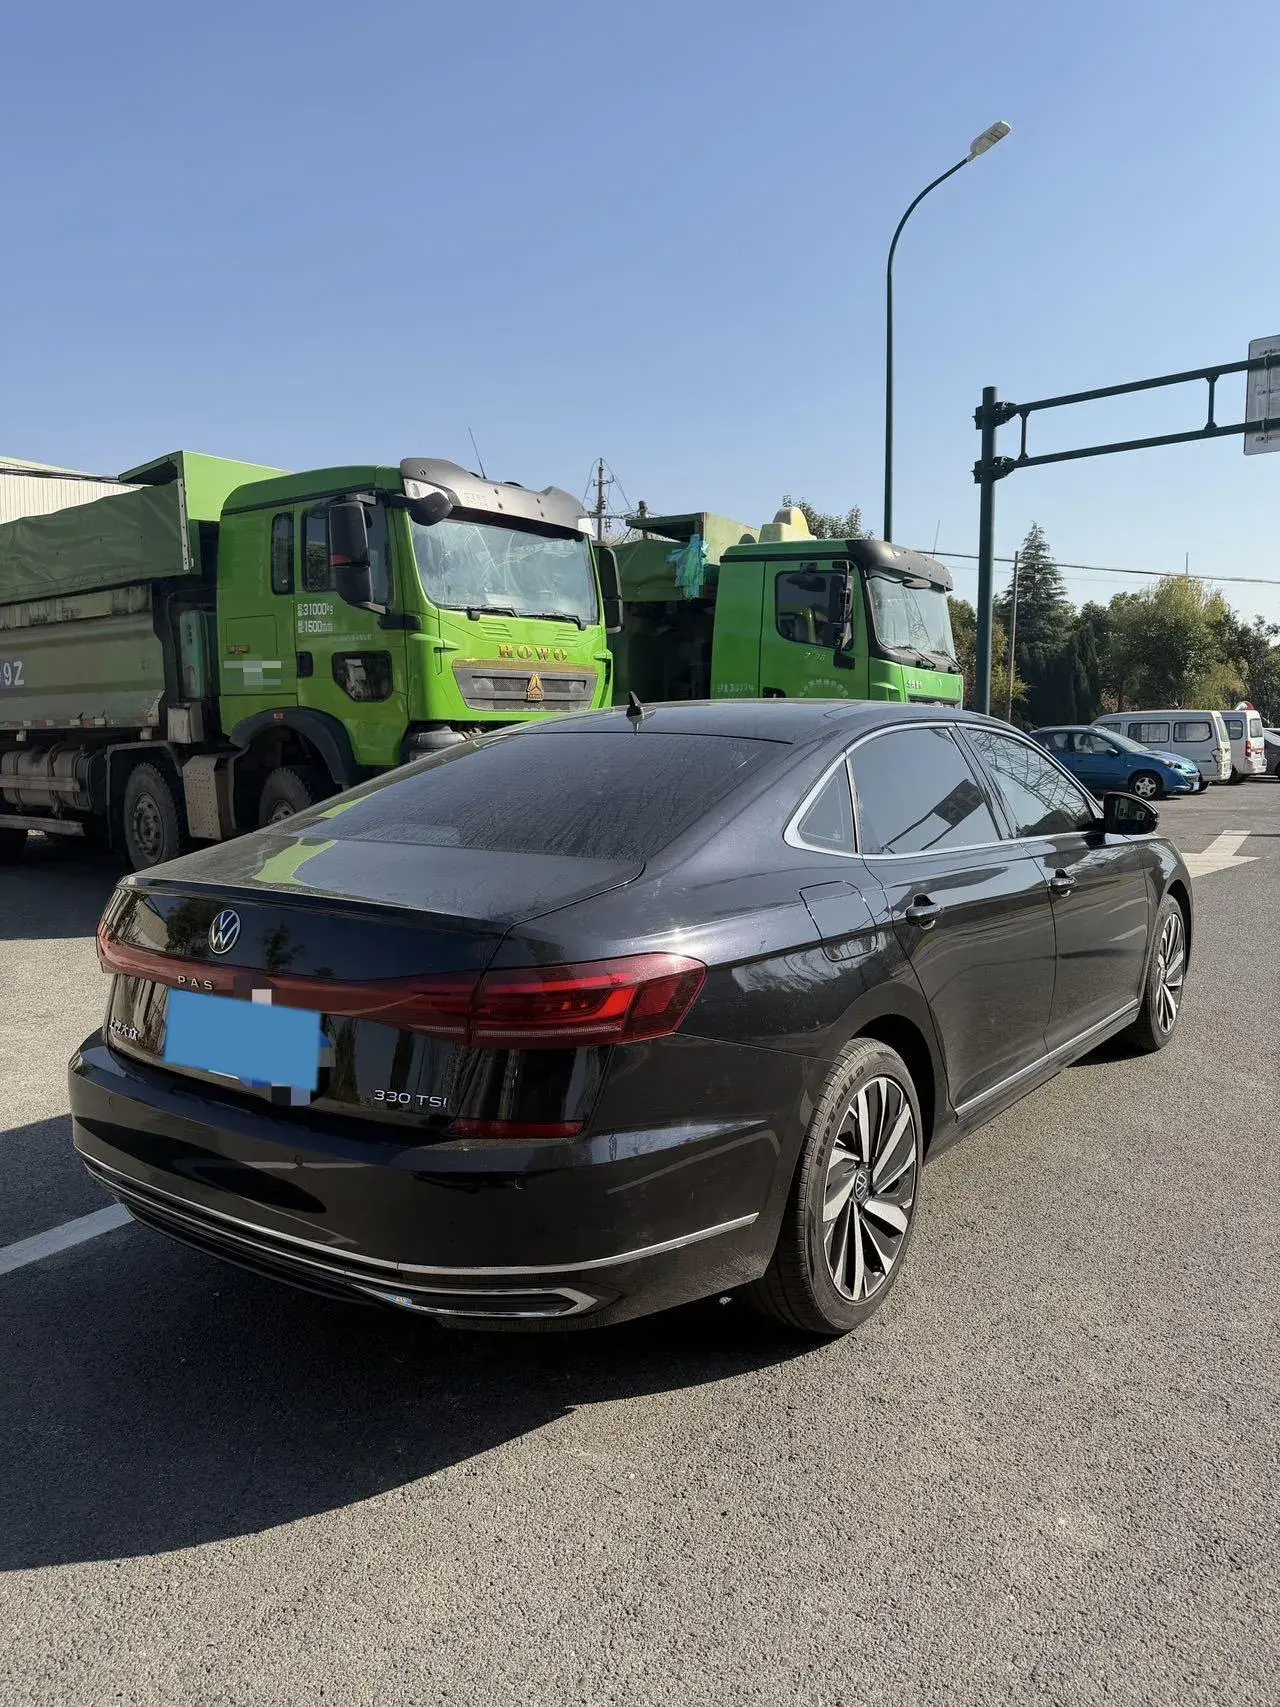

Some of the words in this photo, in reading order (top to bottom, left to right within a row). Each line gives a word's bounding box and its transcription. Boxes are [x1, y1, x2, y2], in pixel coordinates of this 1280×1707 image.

[498, 644, 568, 661] HOWO
[374, 1089, 411, 1104] 330
[416, 1094, 447, 1108] TSI
